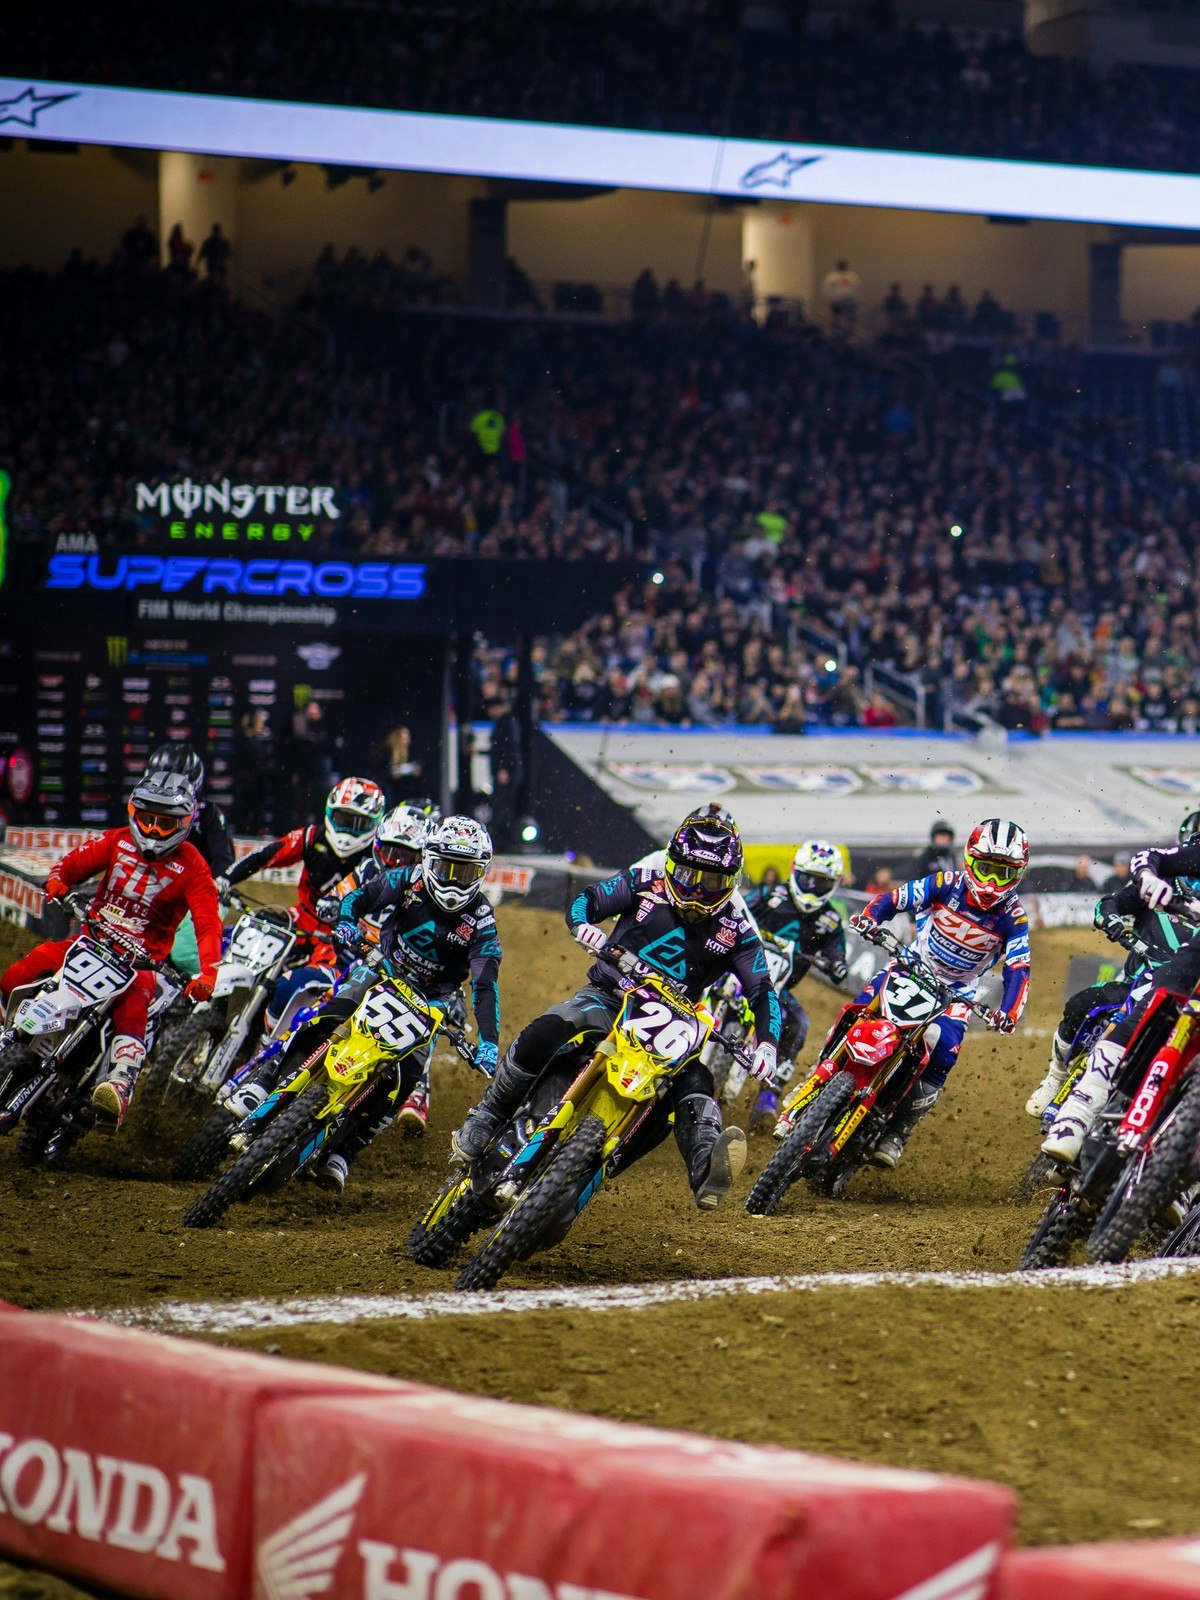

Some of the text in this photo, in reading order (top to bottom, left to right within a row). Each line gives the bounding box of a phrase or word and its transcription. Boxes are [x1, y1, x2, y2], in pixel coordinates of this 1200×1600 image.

[135, 477, 340, 519] MONSTER
[56, 532, 98, 552] AMA
[169, 521, 315, 541] ENERGY
[45, 554, 428, 600] SUPERCROSS
[138, 599, 337, 626] FIM World Championship
[107, 852, 173, 906] FLY
[232, 927, 285, 967] 98
[930, 929, 958, 952] RACE
[65, 951, 127, 1001] 96
[885, 976, 942, 1019] 37
[363, 990, 430, 1050] 55
[621, 1001, 698, 1060] 26
